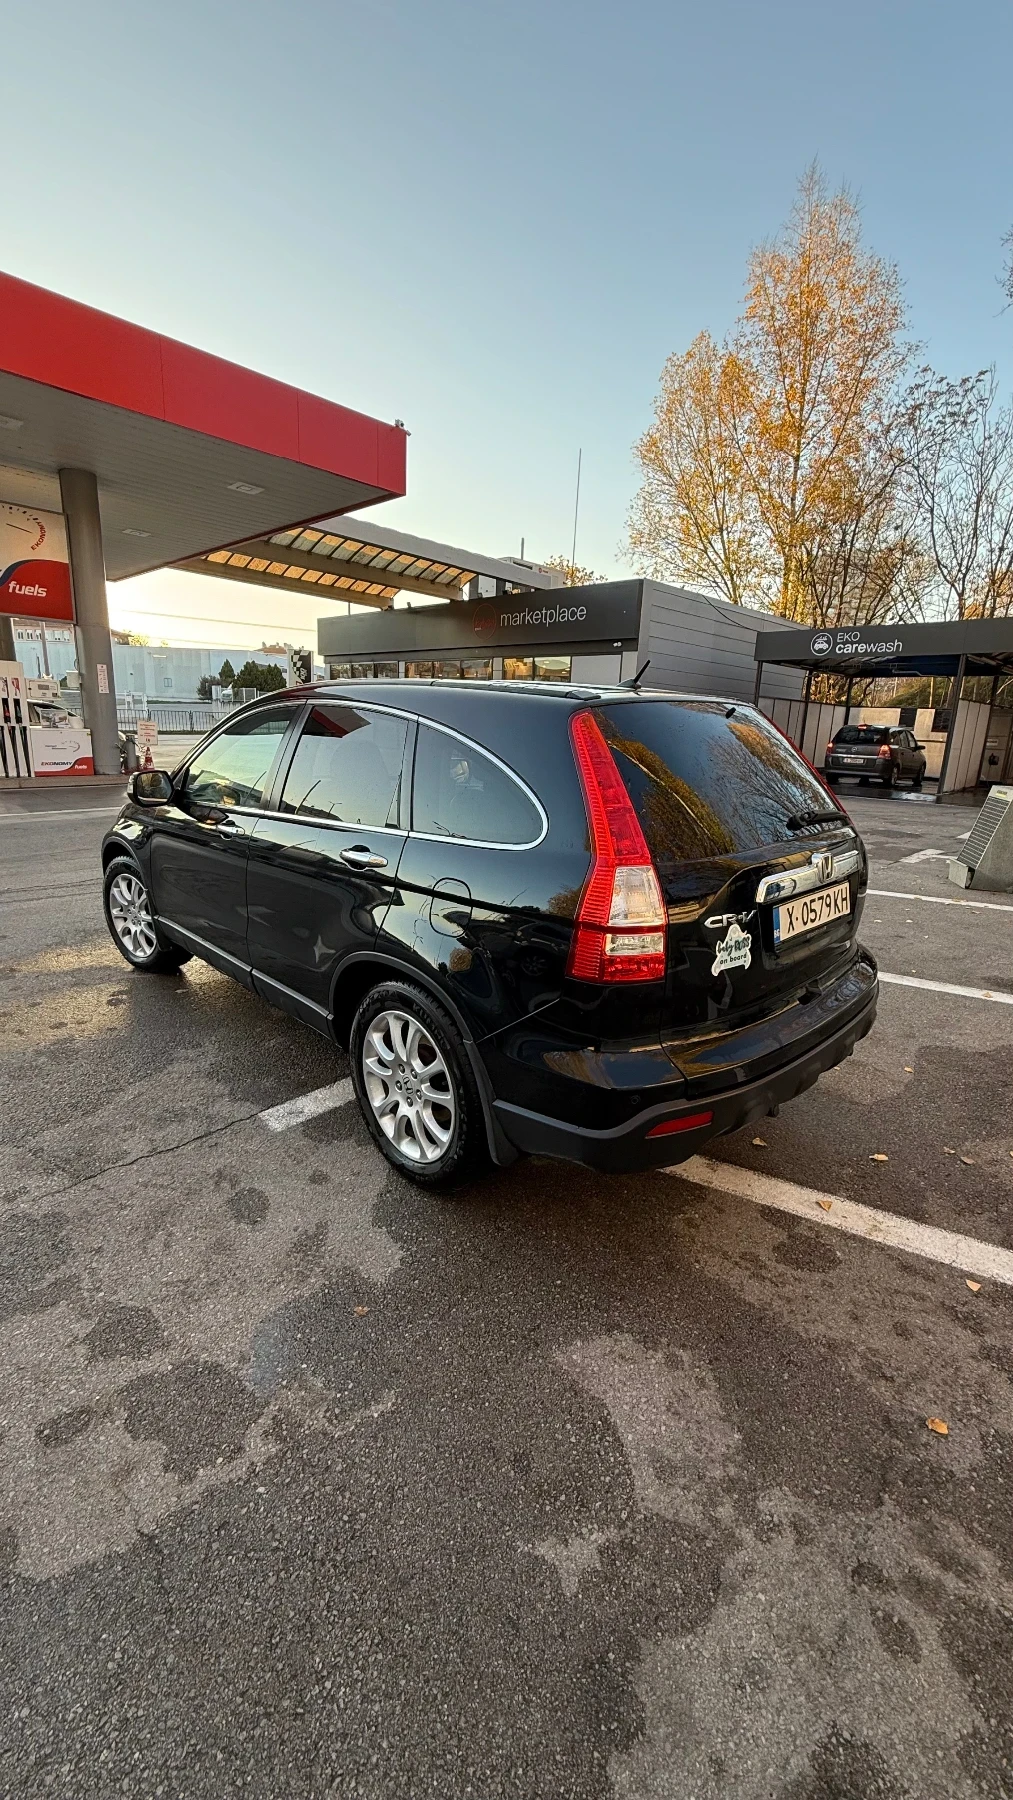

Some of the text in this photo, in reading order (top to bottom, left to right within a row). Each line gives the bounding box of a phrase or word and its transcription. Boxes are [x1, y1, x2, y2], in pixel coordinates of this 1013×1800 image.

[8, 580, 47, 598] fuels
[500, 604, 587, 627] marketplace
[836, 631, 860, 643] EKO
[835, 639, 903, 654] carewash
[704, 910, 757, 928] CR-V
